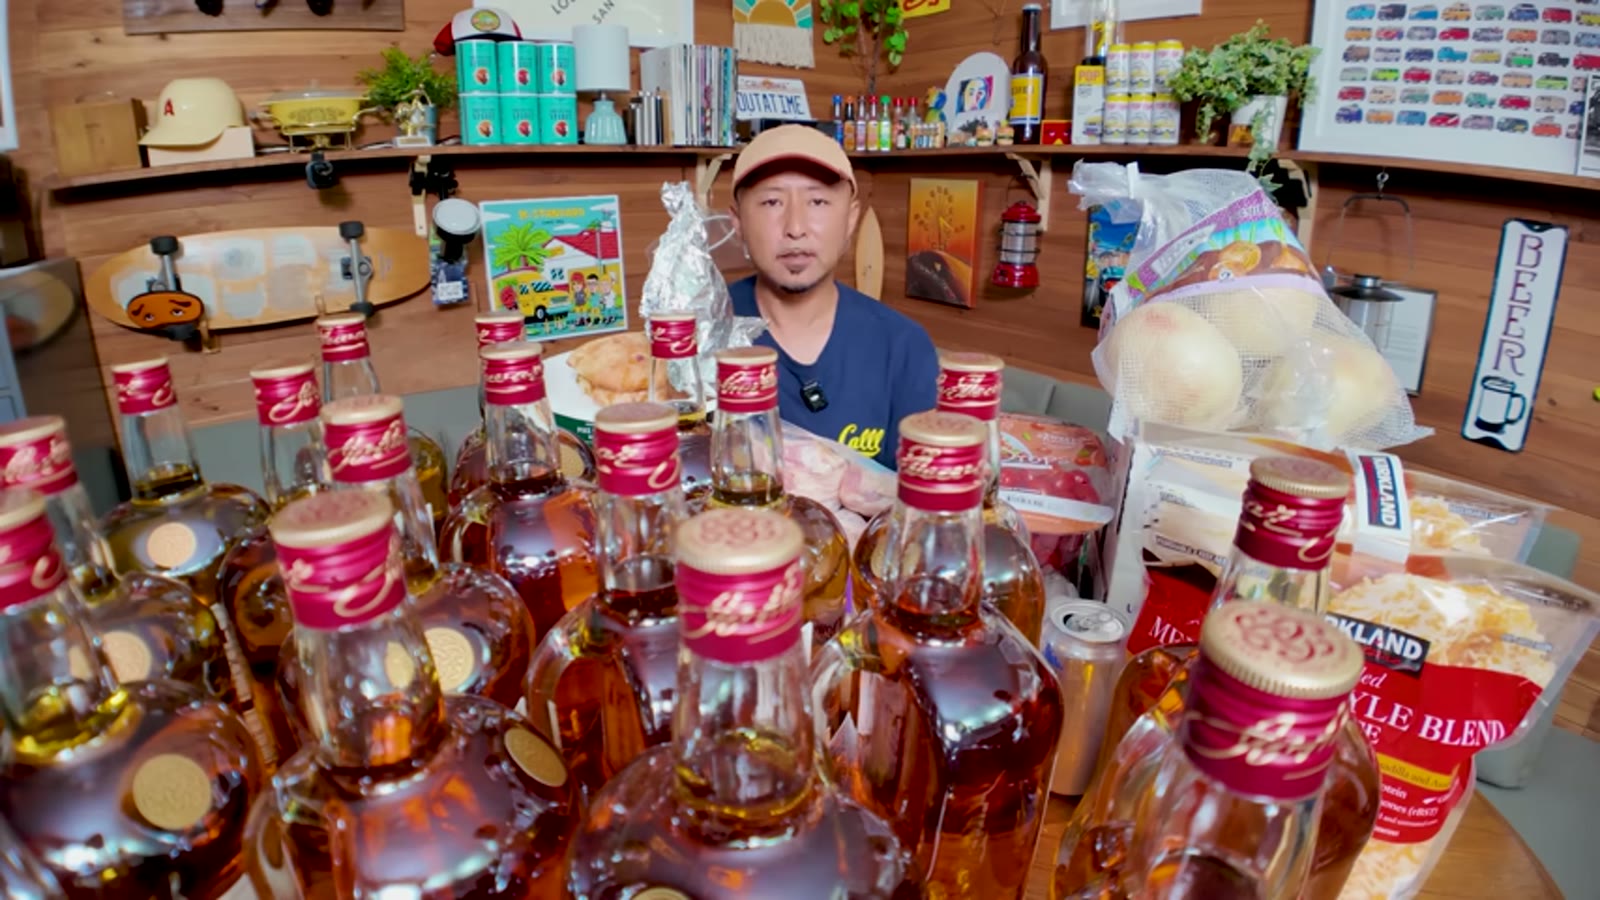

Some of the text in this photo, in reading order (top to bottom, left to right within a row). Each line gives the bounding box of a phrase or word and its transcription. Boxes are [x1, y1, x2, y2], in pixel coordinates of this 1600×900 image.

[163, 98, 175, 116] A
[736, 92, 805, 115] OUTATIME
[1492, 234, 1544, 376] BEER
[1372, 455, 1398, 527] KIRKLAND
[1324, 615, 1423, 661] KLAND
[1418, 714, 1506, 747] BLEND
